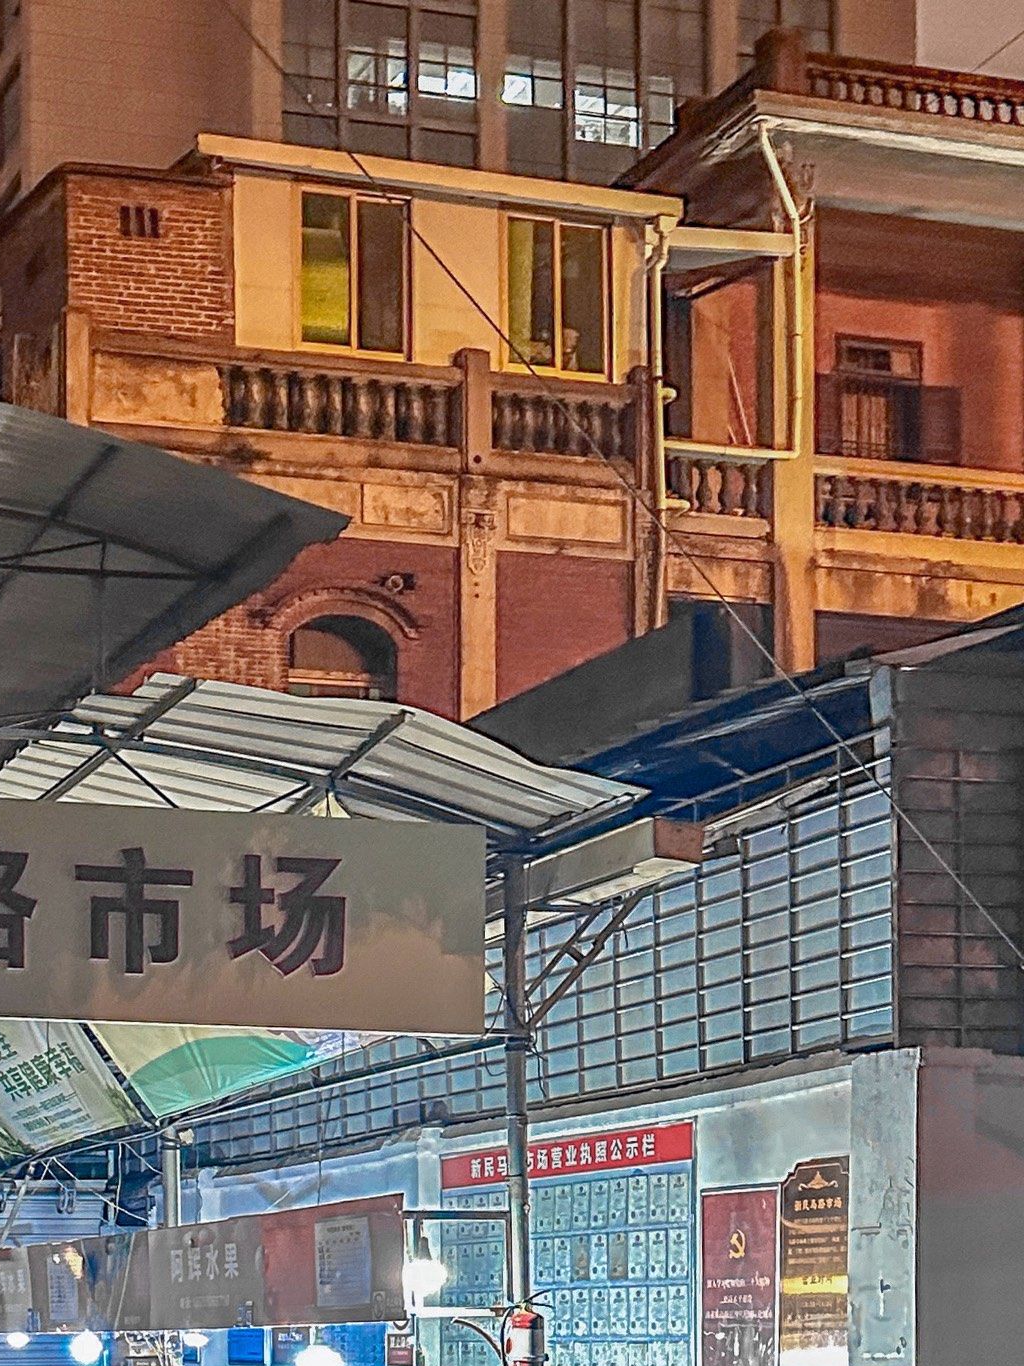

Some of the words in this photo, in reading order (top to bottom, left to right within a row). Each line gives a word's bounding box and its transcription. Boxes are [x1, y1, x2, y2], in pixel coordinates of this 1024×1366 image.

[469, 1132, 657, 1180] 新民马市场营业执照公示栏
